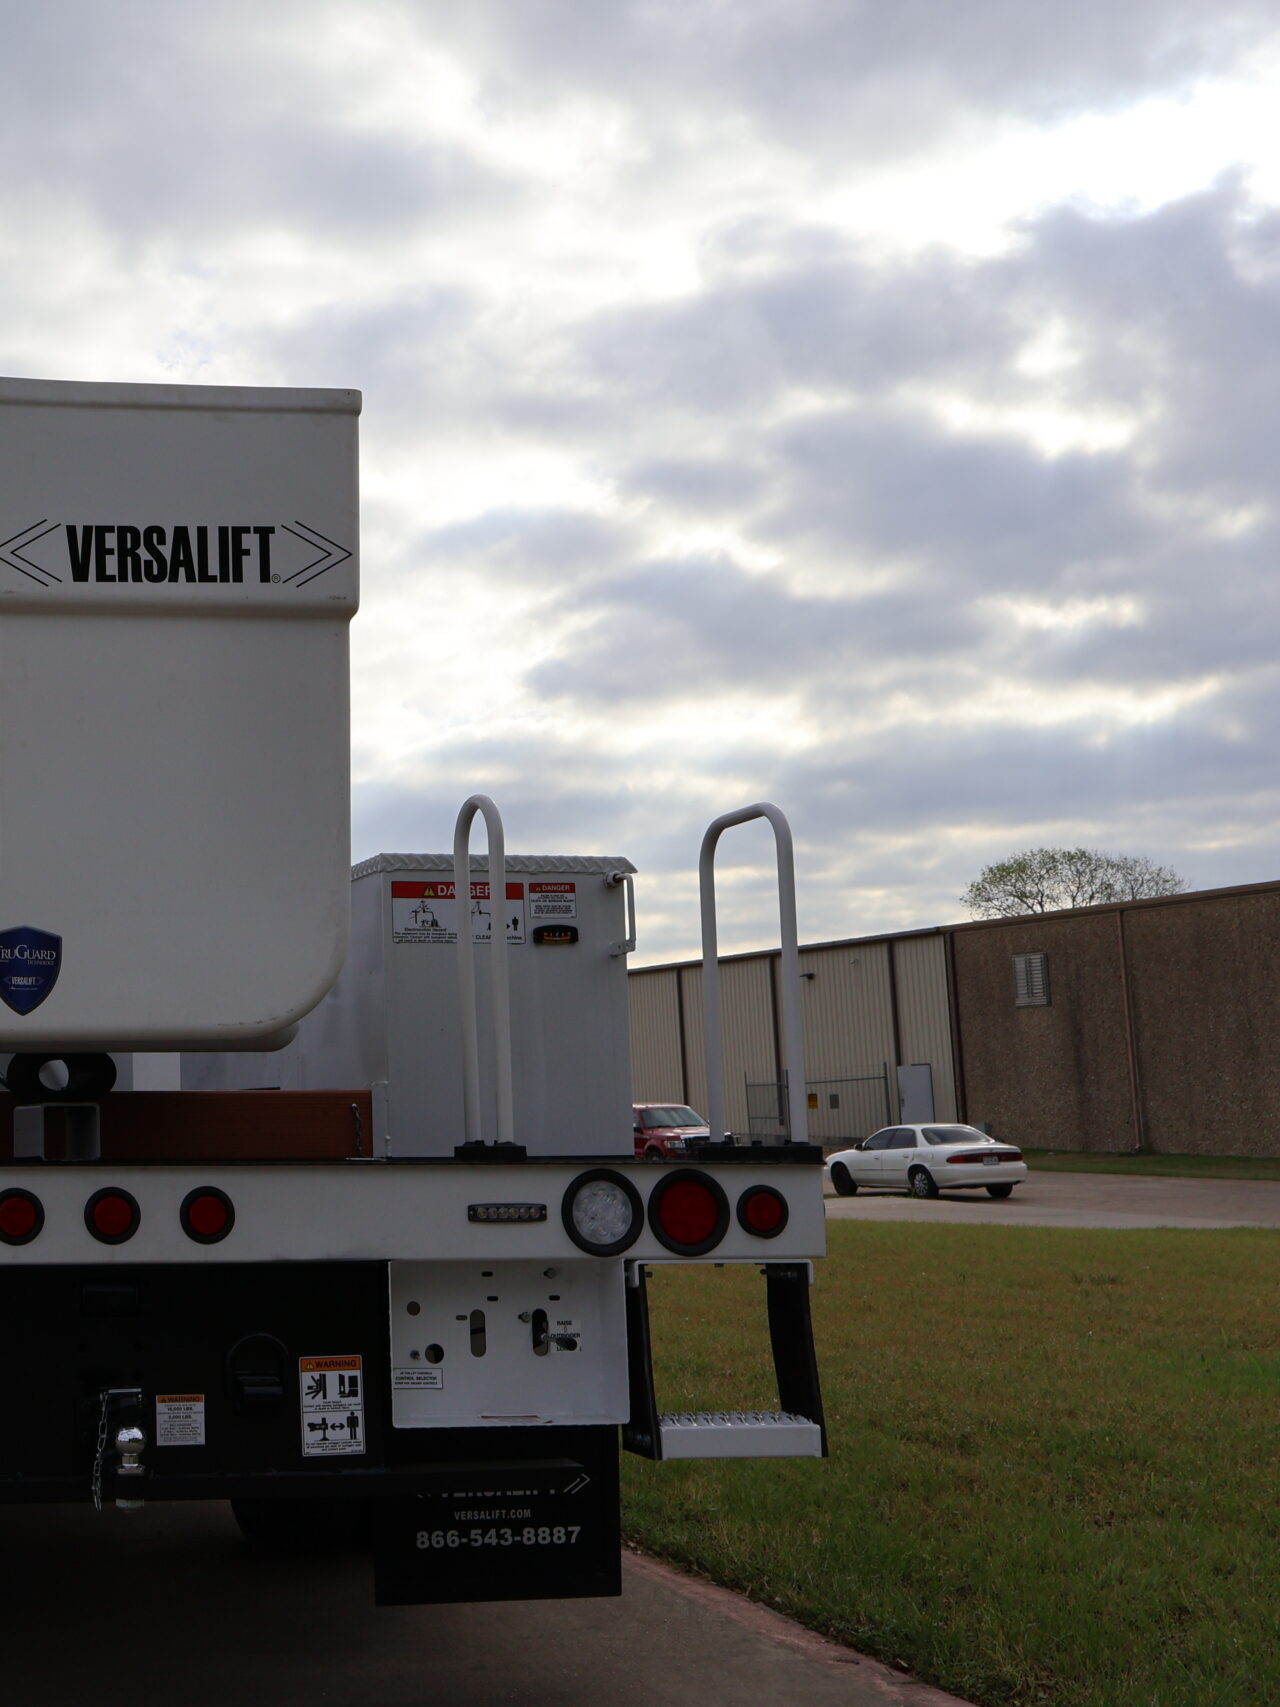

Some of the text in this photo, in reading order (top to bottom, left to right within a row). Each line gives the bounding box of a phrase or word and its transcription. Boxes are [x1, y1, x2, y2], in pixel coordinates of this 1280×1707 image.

[65, 524, 276, 583] VERSALIFT
[437, 885, 491, 897] DAGER
[11, 976, 36, 985] VERSALIFT
[315, 1359, 357, 1369] WARNING
[454, 1509, 531, 1521] VERSALIFT.COM
[416, 1526, 582, 1550] 866-543-8887
